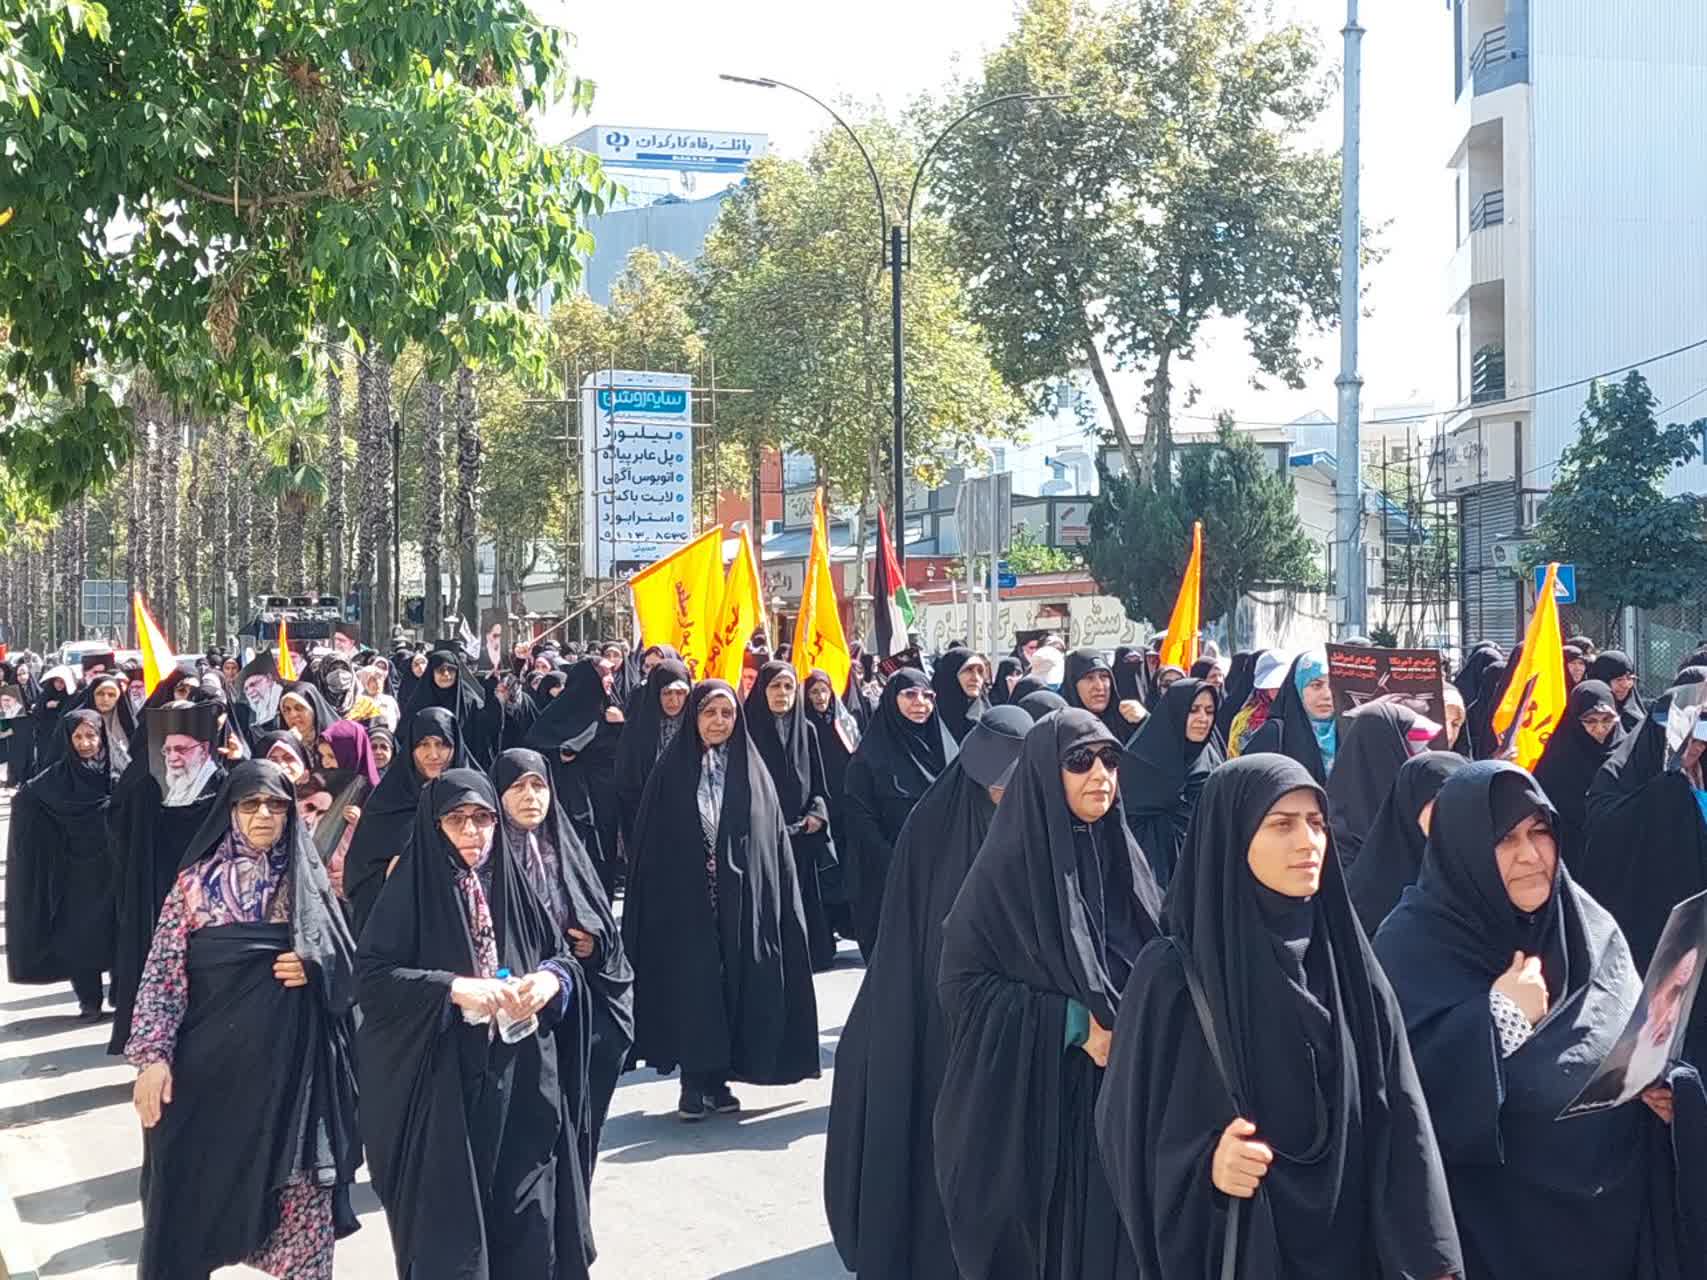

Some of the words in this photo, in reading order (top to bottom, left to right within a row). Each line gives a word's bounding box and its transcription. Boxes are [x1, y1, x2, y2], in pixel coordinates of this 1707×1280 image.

[716, 137, 752, 154] بانک
[602, 425, 673, 444] بیلبورد
[632, 448, 656, 463] عابر
[657, 449, 674, 467] پل
[602, 466, 632, 484] آگهی
[632, 471, 674, 486] اتوبوس
[603, 490, 638, 506] باکس
[641, 491, 673, 505] لایت
[602, 511, 674, 526] استرابورد
